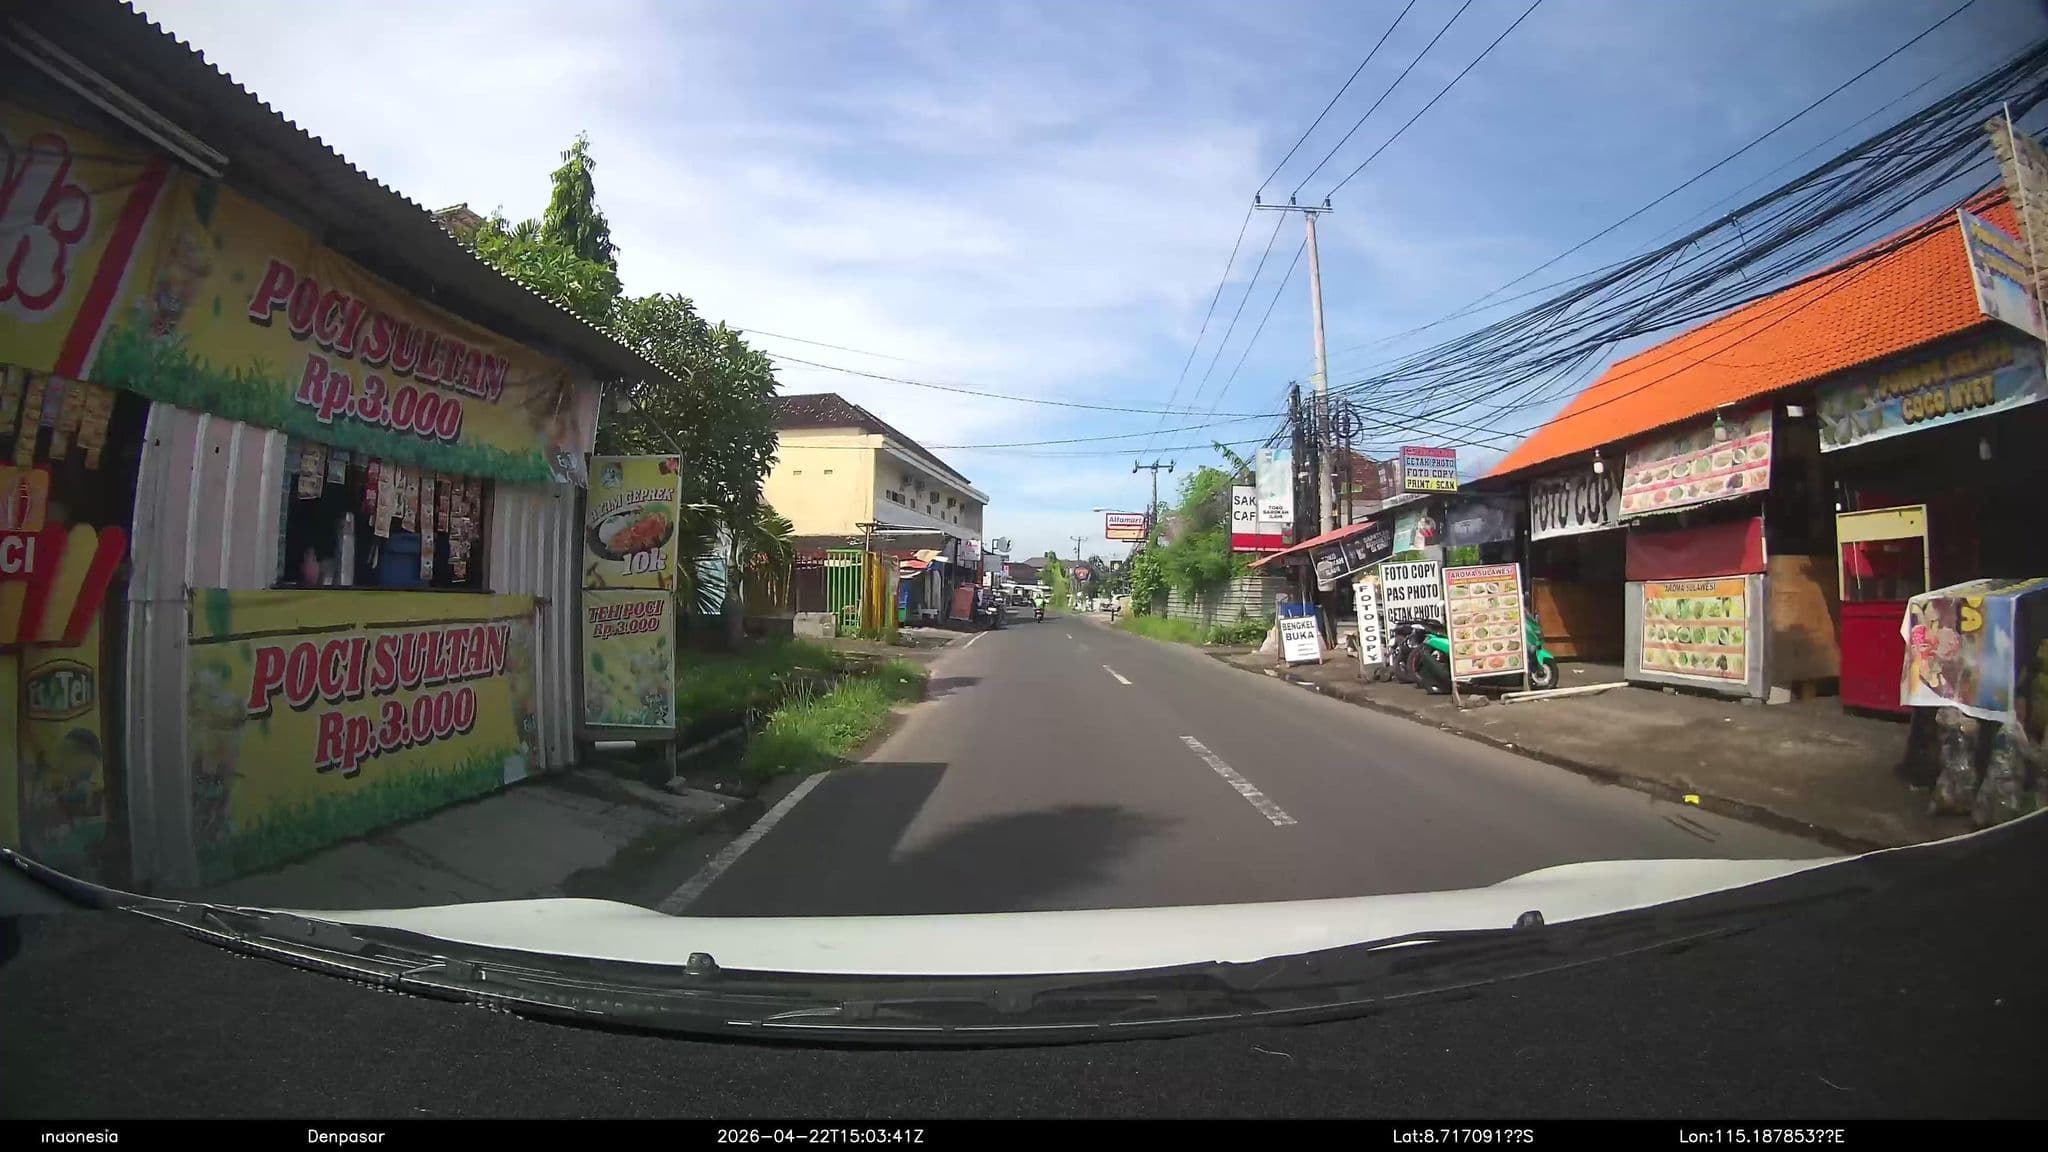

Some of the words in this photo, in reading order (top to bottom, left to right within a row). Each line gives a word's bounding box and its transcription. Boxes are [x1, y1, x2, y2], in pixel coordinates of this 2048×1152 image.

[248, 256, 368, 358] POCI
[360, 311, 509, 400] SULTAN
[295, 352, 464, 441] Rp.3.000
[1431, 458, 1454, 468] PHOTO
[1407, 468, 1429, 478] FOTO
[1432, 469, 1454, 479] COPY
[1436, 480, 1455, 489] SCAN
[591, 493, 623, 522] AYAM
[625, 487, 674, 506] GEPREK
[1109, 516, 1143, 524] Alfamart
[1384, 565, 1409, 581] FOTO
[1411, 563, 1436, 579] COPY
[1386, 586, 1405, 602] PAS
[1407, 584, 1439, 600] PHOTO
[588, 604, 624, 624] TEH
[622, 600, 665, 620] POCI
[1387, 607, 1412, 622] CETAK
[1413, 604, 1440, 620] PHOTO
[1281, 620, 1315, 631] BENGKEL
[1285, 631, 1315, 641] BUKA
[248, 636, 370, 718] POCI
[370, 621, 510, 695] SULTAN
[314, 686, 477, 777] Rp.3.000
